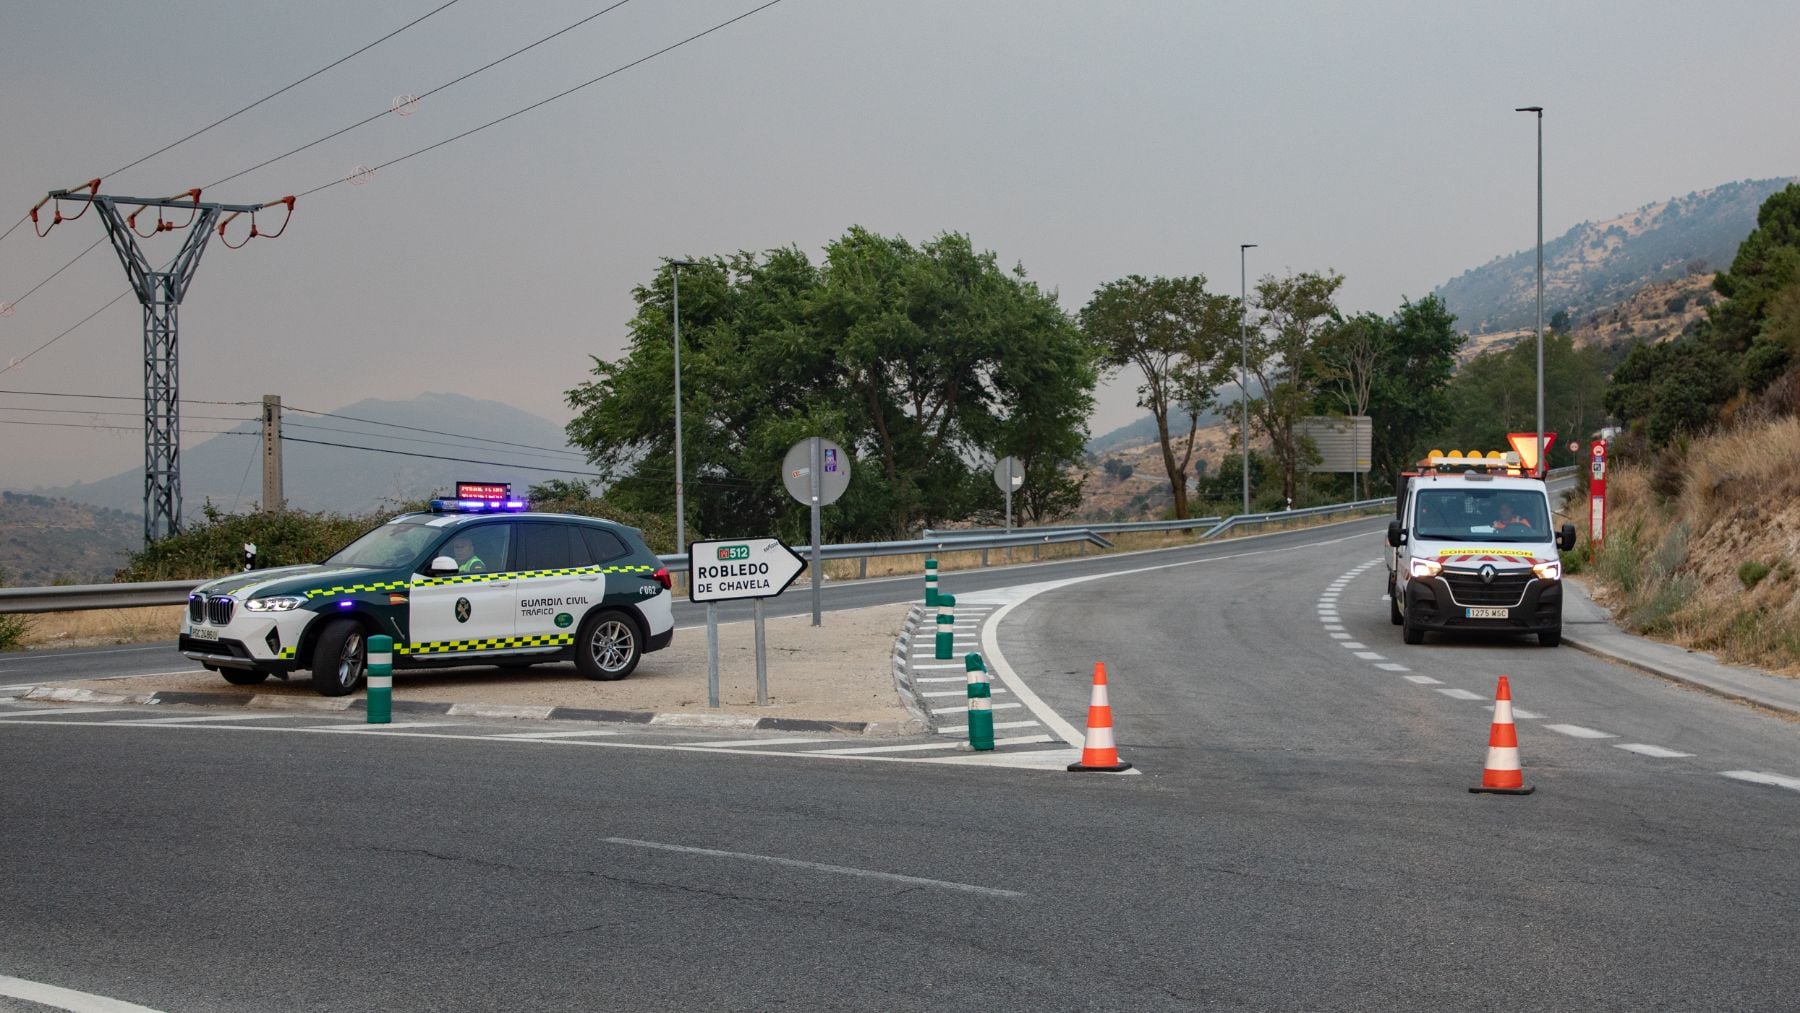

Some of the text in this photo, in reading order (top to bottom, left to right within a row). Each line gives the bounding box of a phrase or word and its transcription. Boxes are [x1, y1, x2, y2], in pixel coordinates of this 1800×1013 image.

[730, 547, 748, 559] 512
[698, 562, 769, 579] ROBLEDO
[698, 579, 770, 593] DE CHAVELA
[521, 596, 589, 608] GUARDIA CIVIL
